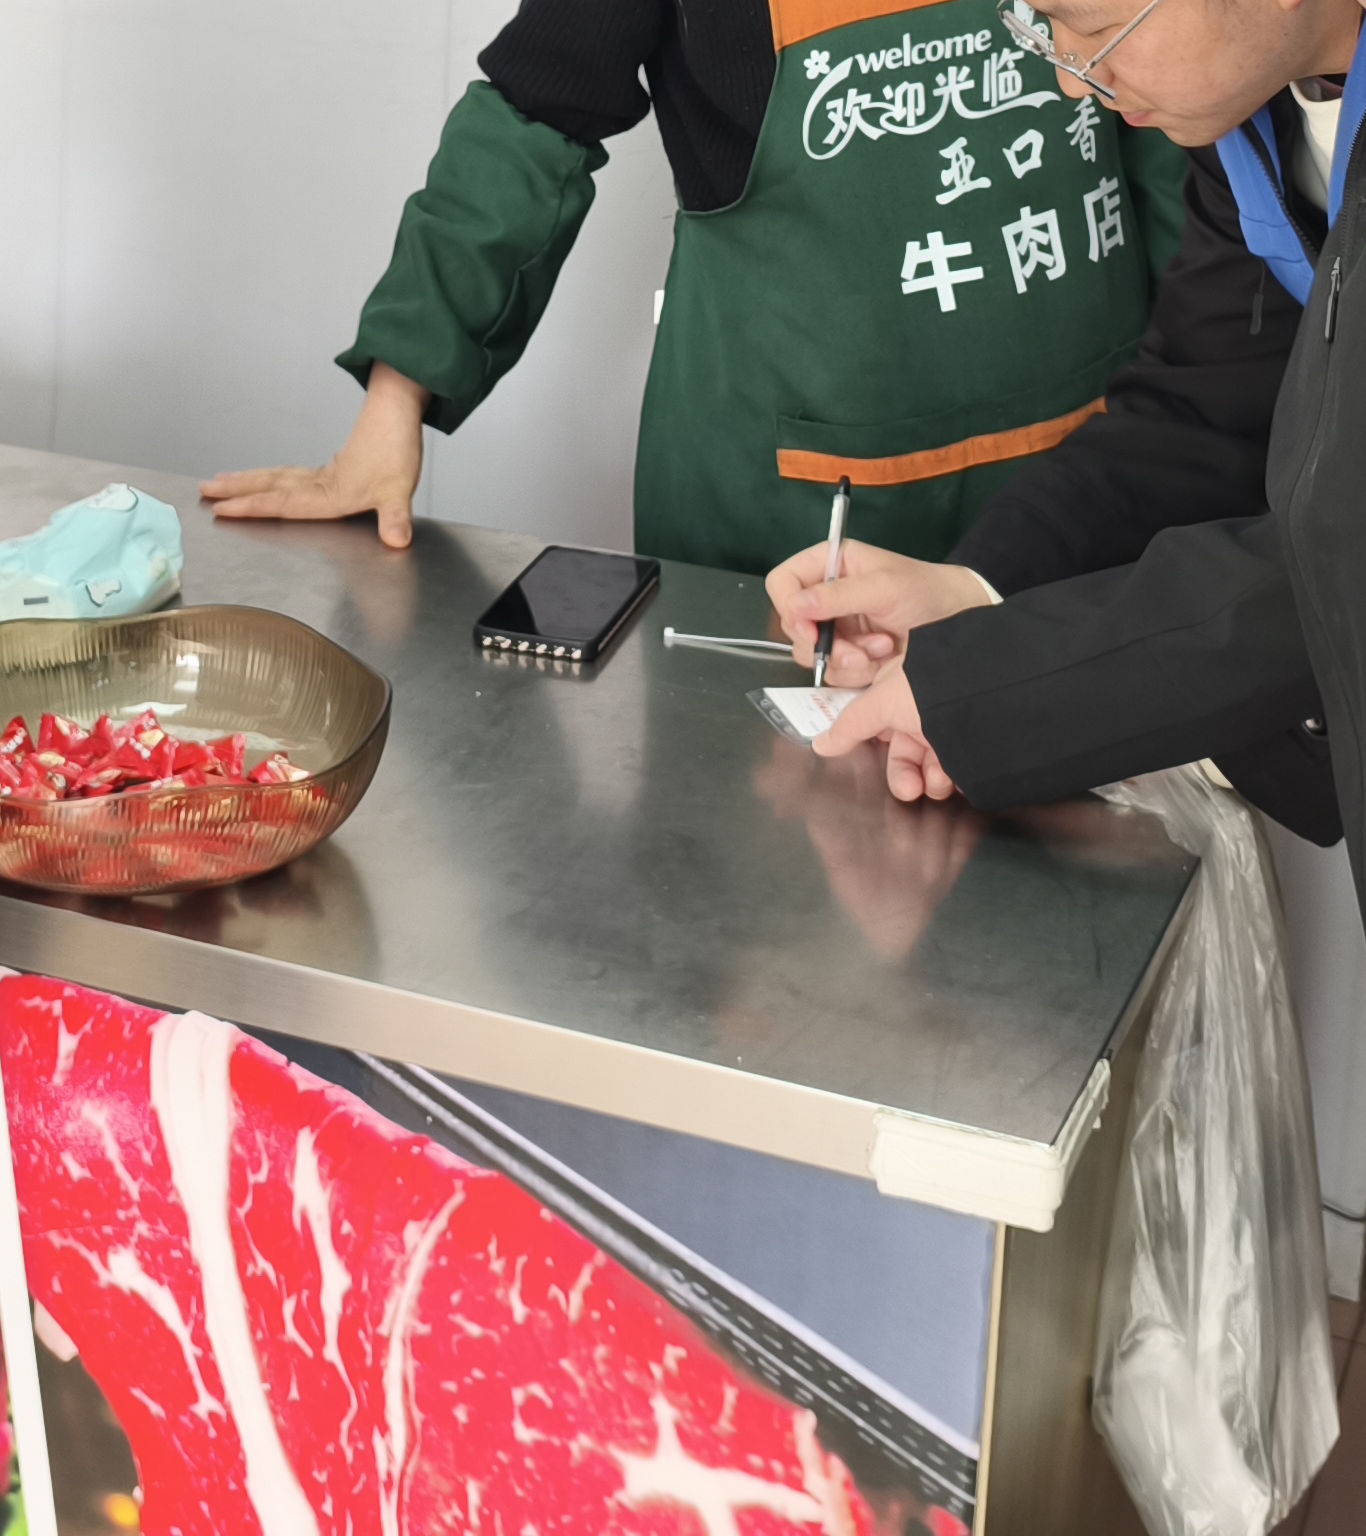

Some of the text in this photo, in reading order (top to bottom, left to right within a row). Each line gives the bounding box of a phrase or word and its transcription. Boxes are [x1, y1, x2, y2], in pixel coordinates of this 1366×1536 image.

[821, 47, 1027, 147] 欢迎光临
[855, 29, 992, 74] welcome
[900, 176, 1126, 313] 牛肉店
